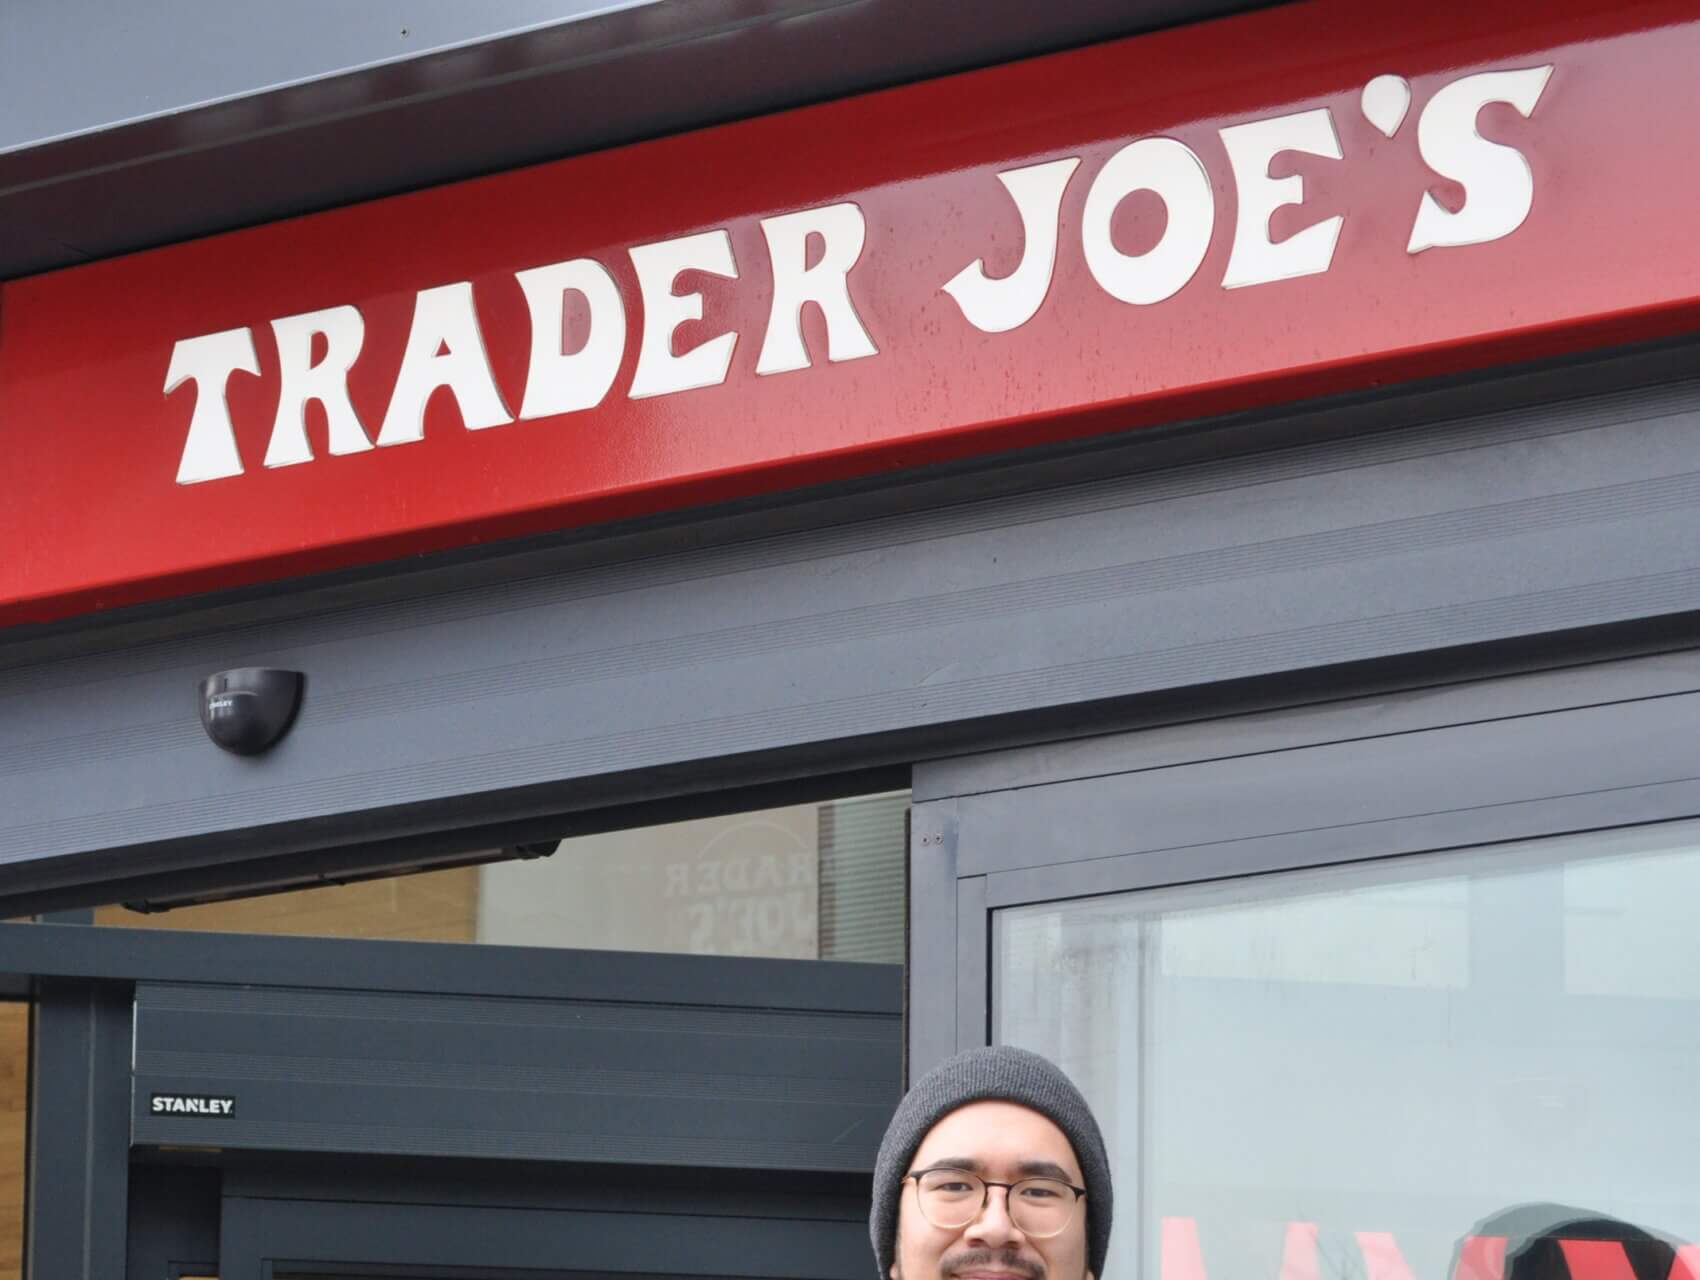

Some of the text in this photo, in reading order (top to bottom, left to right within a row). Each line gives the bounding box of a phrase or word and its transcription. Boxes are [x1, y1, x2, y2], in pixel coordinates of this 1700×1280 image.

[163, 65, 1555, 485] TRADER JOE'S
[152, 1096, 233, 1114] STANLEY
